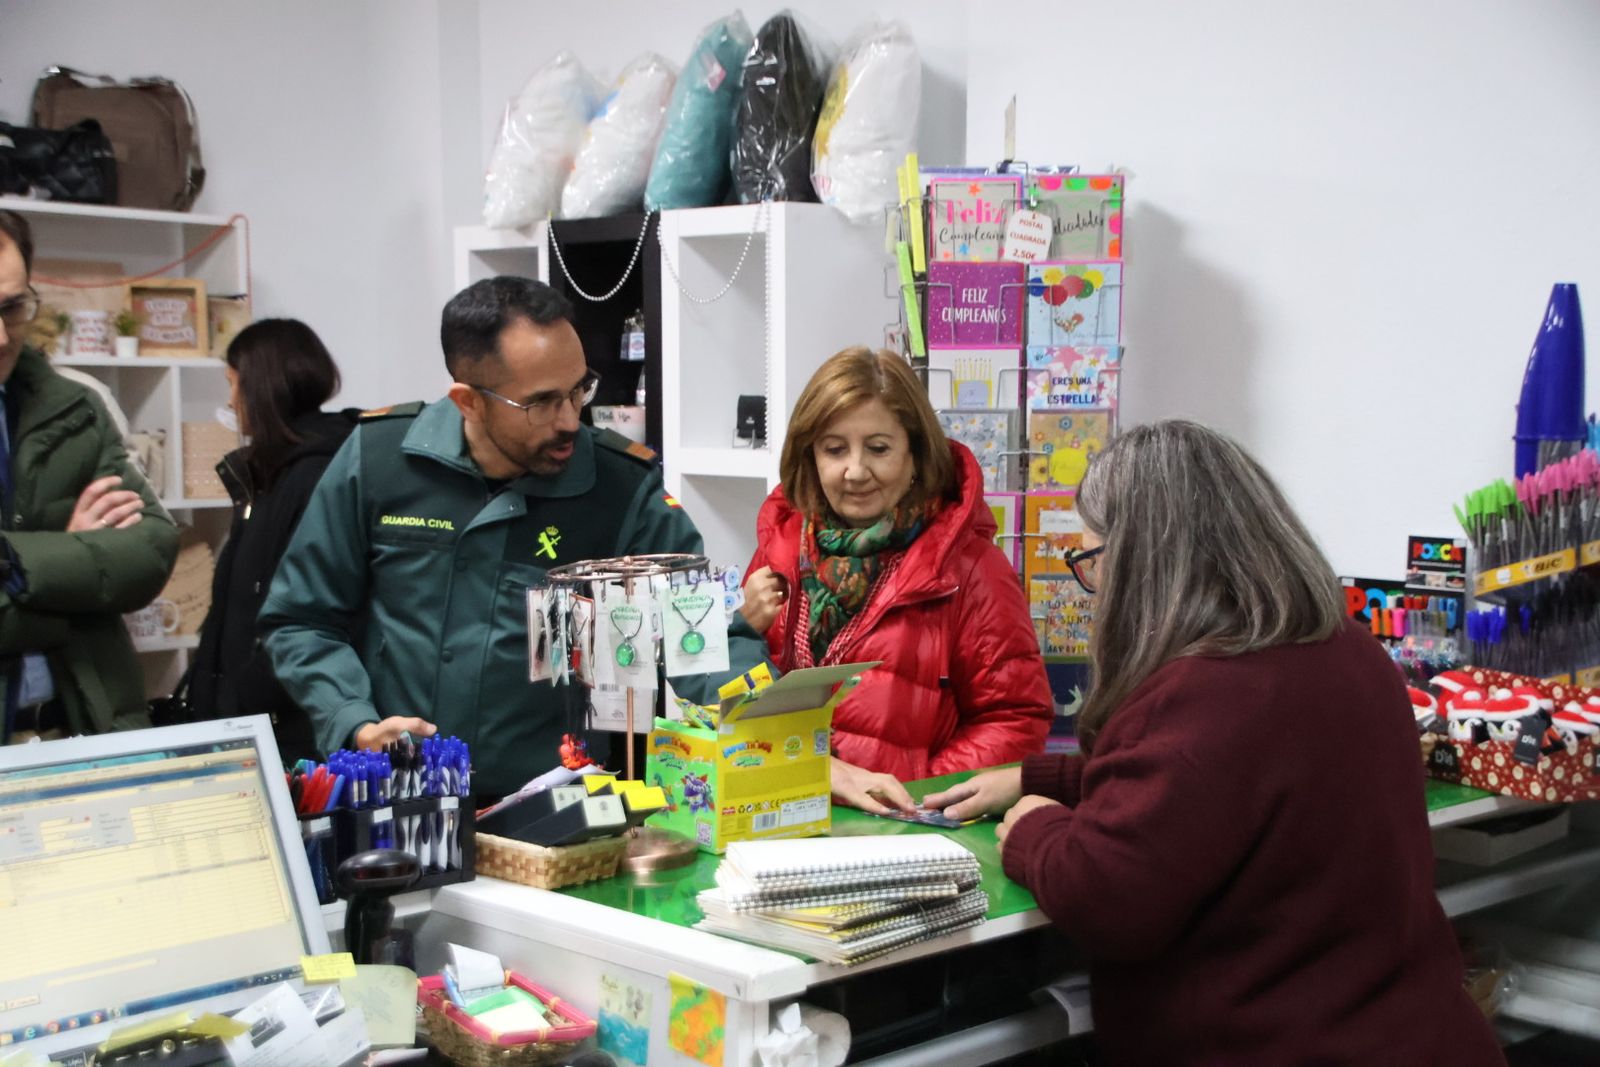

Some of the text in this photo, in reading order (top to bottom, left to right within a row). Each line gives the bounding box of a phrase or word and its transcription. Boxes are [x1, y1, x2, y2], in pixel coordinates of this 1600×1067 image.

[945, 198, 1007, 225] Feliz
[1019, 218, 1044, 230] POSTAL
[1053, 209, 1105, 236] elicidade
[1009, 231, 1047, 246] CUADRADA
[962, 287, 988, 304] FELIZ
[941, 304, 1007, 324] CUMPLEAÑOS
[1052, 376, 1092, 386] ERES UNA
[1047, 394, 1099, 405] ESTRELLA
[381, 515, 455, 531] GUARDIA CIVIL
[1412, 541, 1463, 561] POSCA
